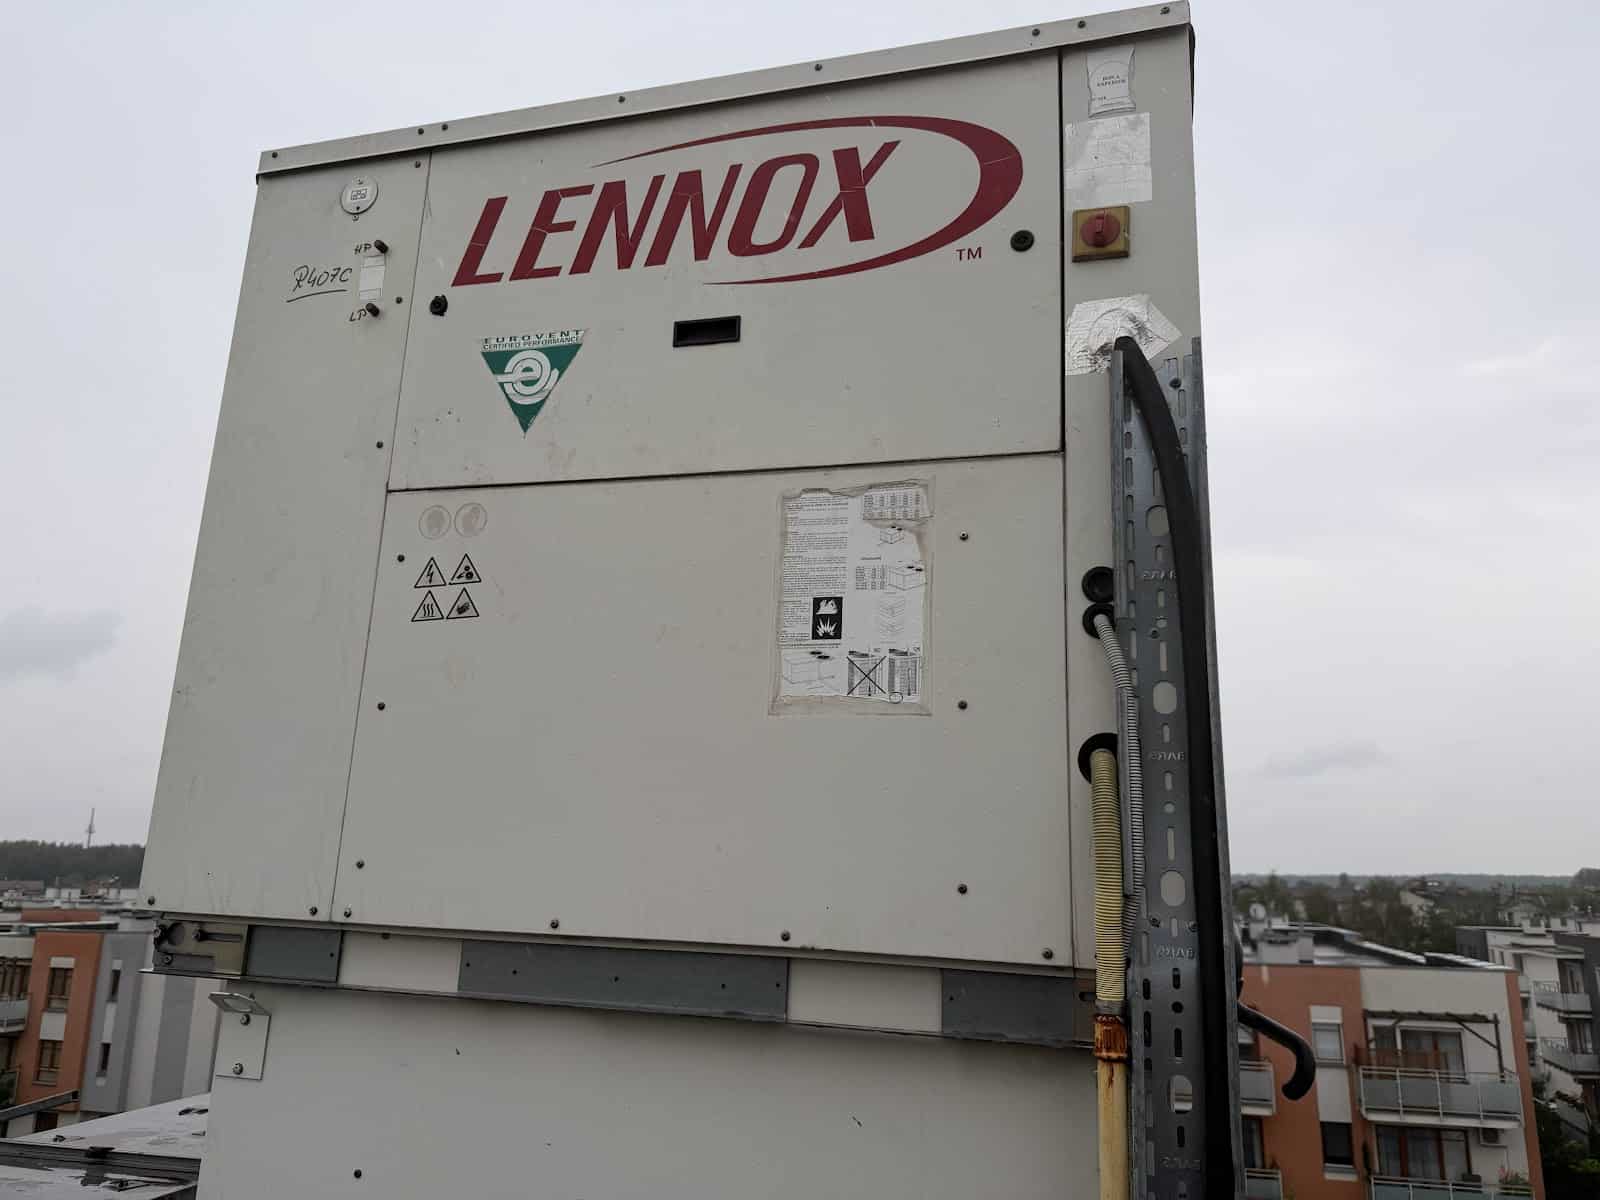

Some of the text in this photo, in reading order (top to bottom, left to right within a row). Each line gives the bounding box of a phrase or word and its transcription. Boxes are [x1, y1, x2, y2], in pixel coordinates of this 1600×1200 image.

[451, 140, 901, 287] LENNOX
[354, 243, 372, 255] HP
[955, 246, 982, 262] TM
[292, 265, 353, 293] R407C
[348, 309, 367, 322] LP
[483, 329, 585, 344] EUROVENT
[483, 335, 579, 352] CERTIFIED PERFORMANCE
